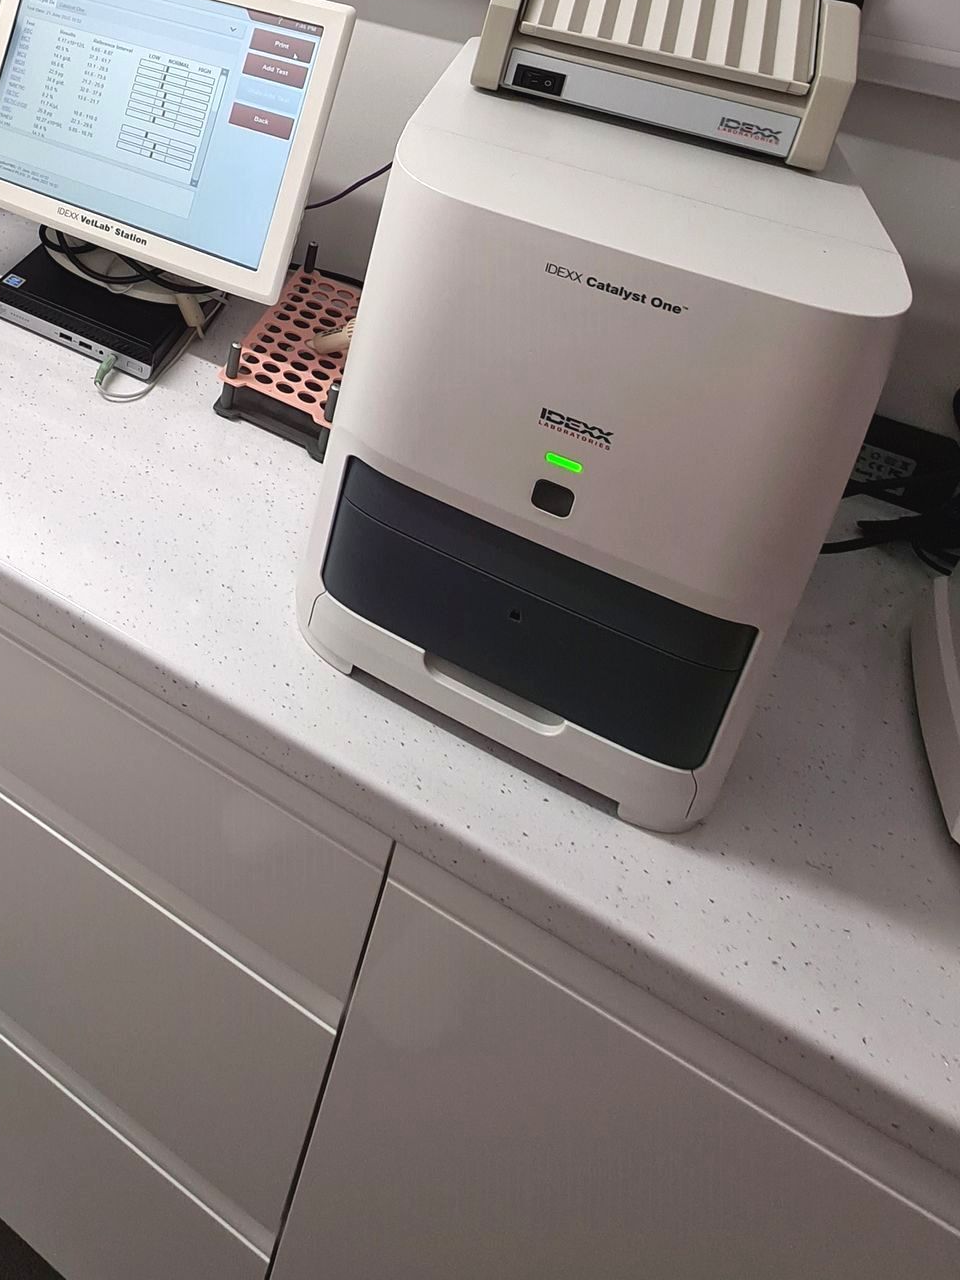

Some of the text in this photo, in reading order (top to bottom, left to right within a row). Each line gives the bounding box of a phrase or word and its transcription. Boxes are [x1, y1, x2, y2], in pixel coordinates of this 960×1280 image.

[274, 40, 289, 49] Print
[168, 58, 189, 69] NORMAL
[198, 66, 212, 75] HIGH
[262, 64, 289, 76] Add Test
[254, 115, 269, 125] Back
[720, 117, 782, 141] IDEXX
[718, 127, 778, 145] LABORATORIES
[57, 207, 79, 221] IDEXX
[114, 228, 148, 246] Station
[544, 262, 583, 283] IDEXX
[586, 276, 647, 304] Catalyst
[538, 420, 611, 451] LABORATORIES
[540, 407, 614, 444] IDEXX
